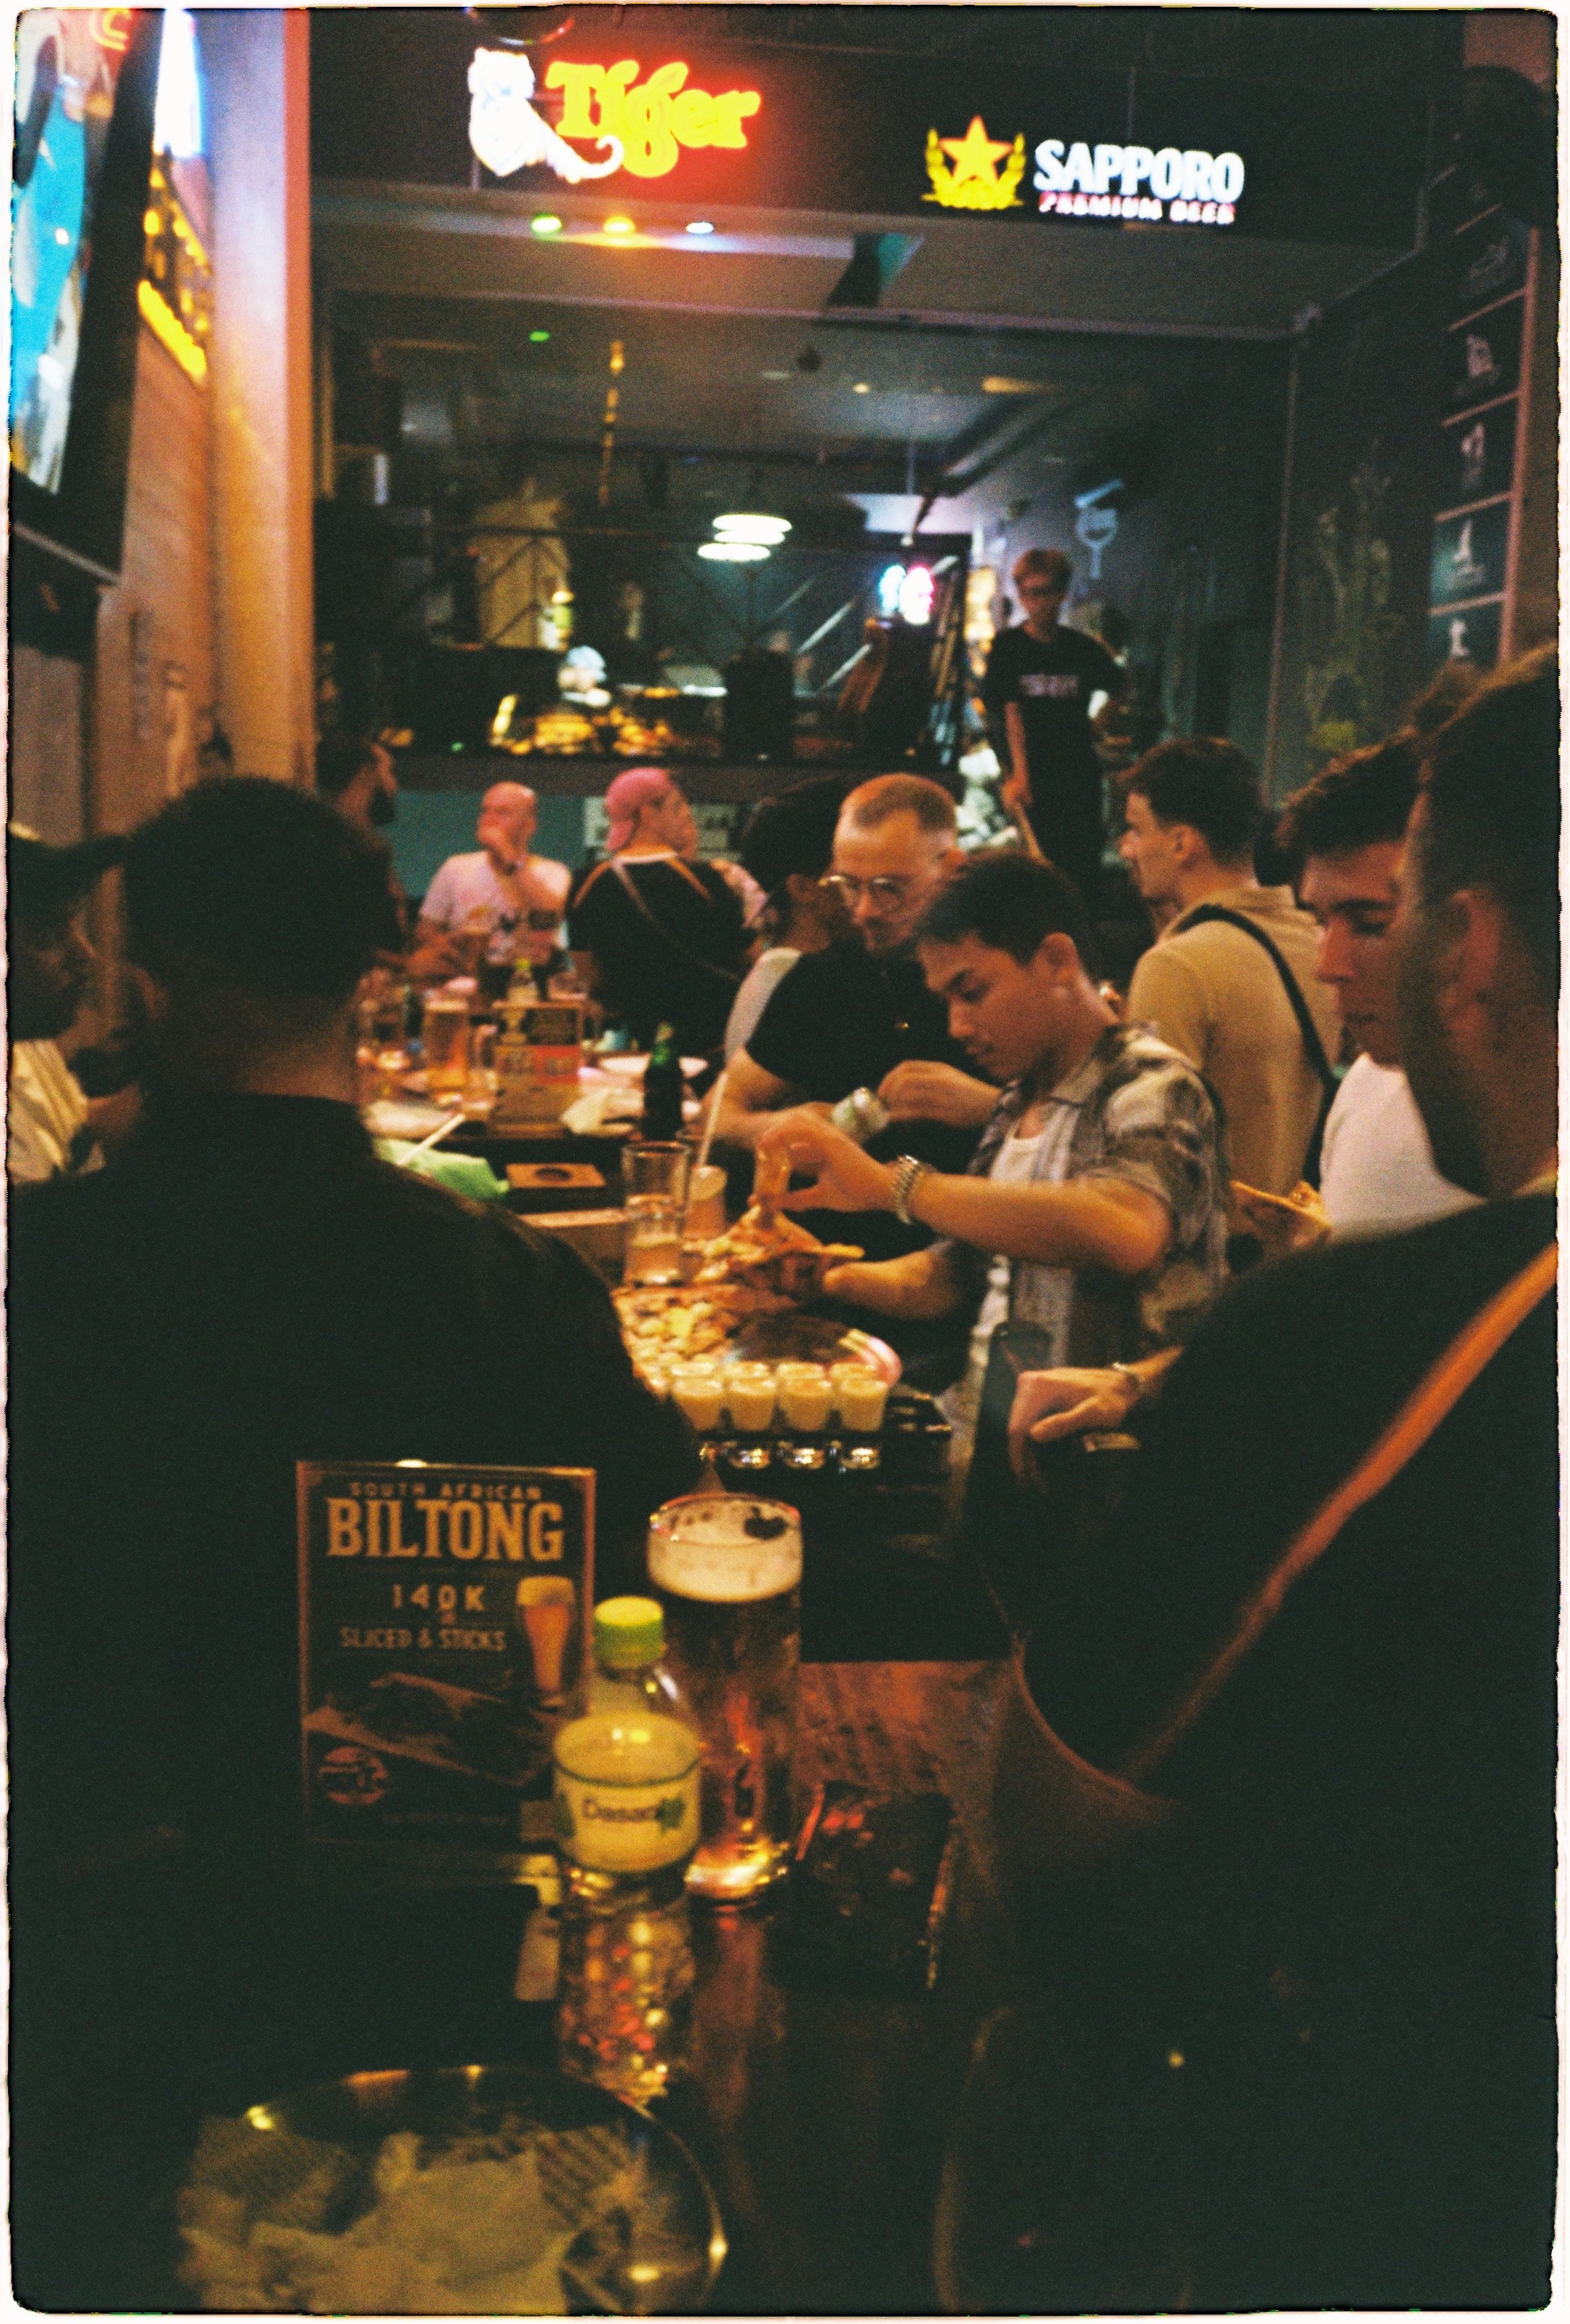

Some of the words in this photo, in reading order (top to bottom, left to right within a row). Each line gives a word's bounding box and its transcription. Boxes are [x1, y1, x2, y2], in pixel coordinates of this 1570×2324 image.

[546, 60, 761, 178] Tiger
[1033, 139, 1245, 204] SAPPORO
[349, 1481, 427, 1498] SOUTH
[440, 1482, 543, 1501] AFRICAN
[326, 1496, 565, 1562] BILTONG
[340, 1626, 412, 1649] SLICED
